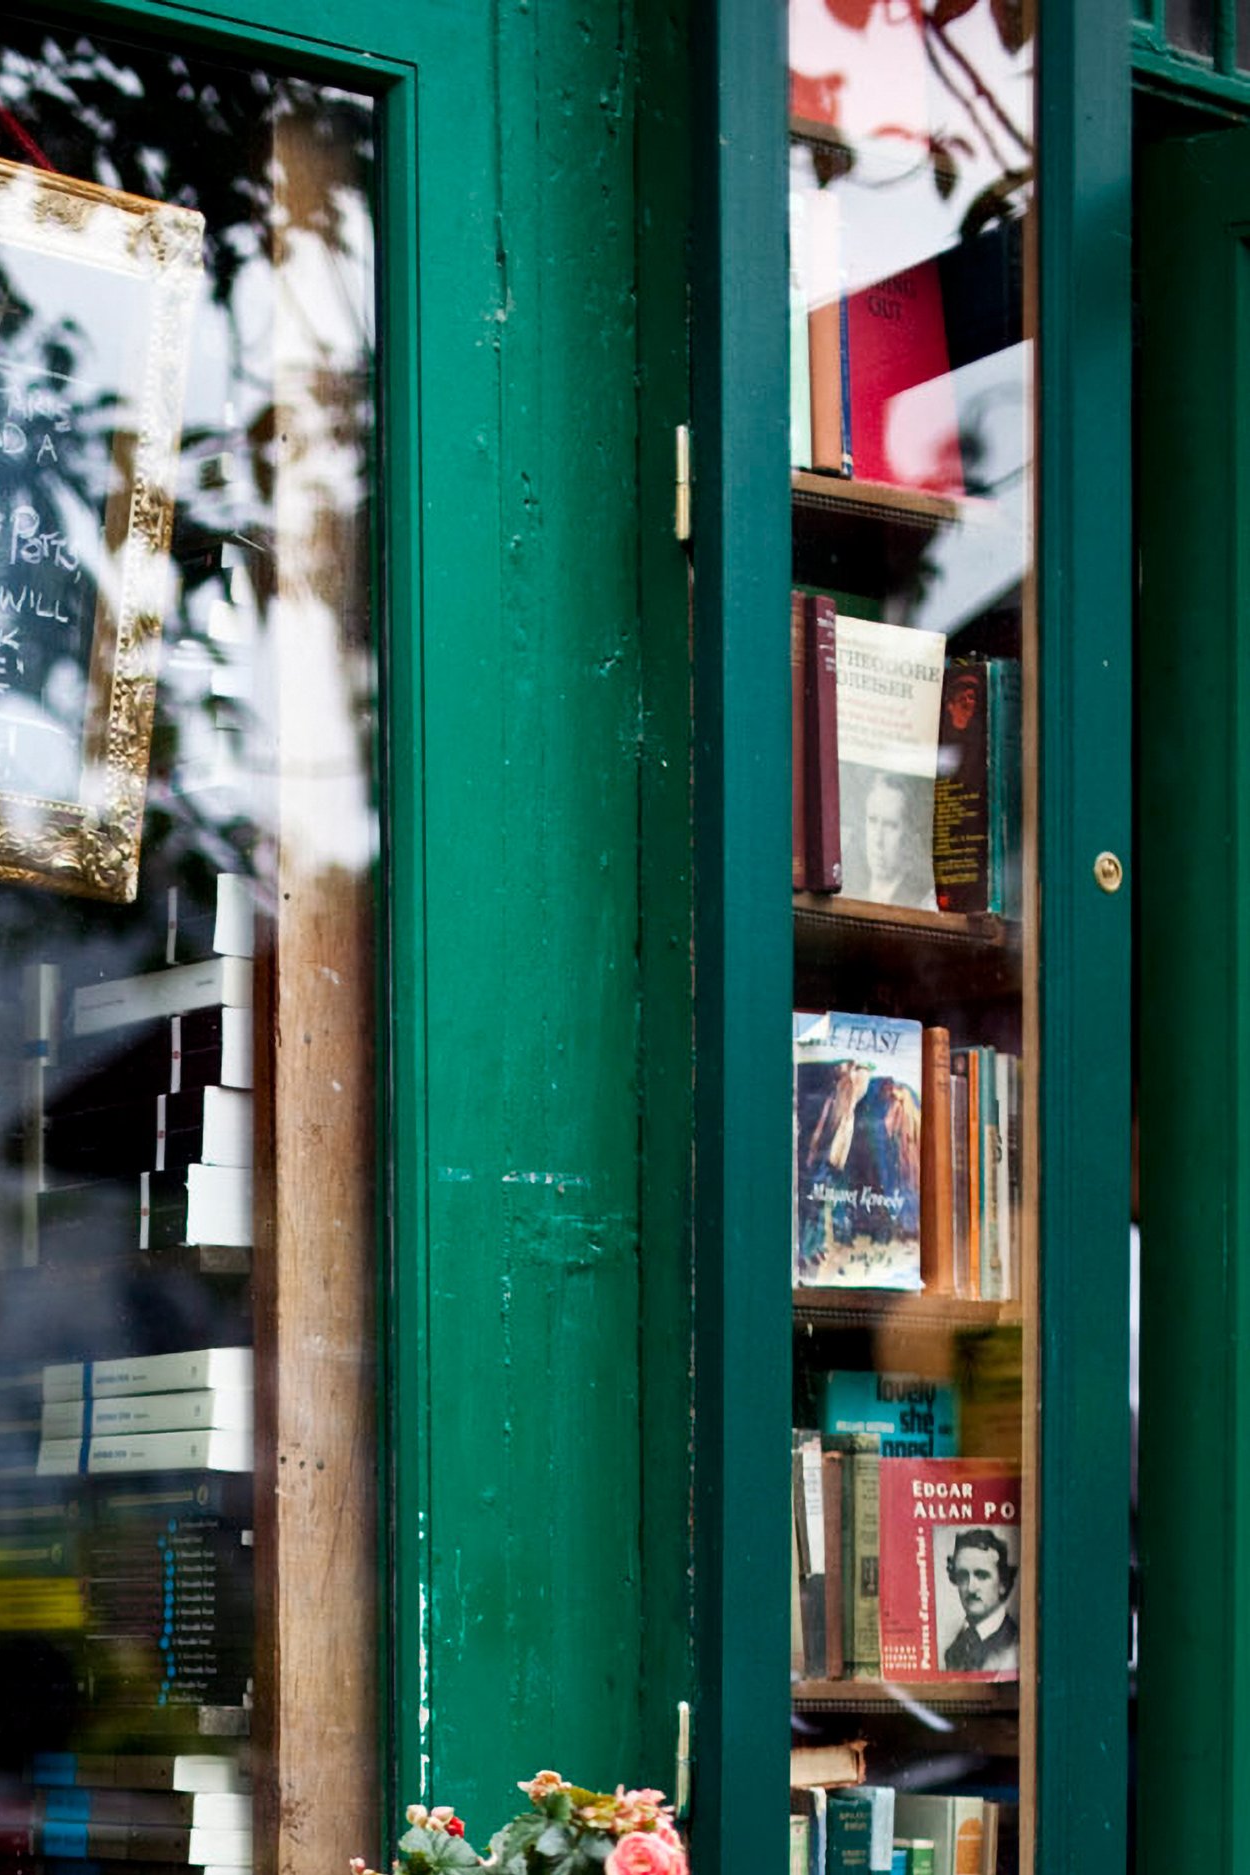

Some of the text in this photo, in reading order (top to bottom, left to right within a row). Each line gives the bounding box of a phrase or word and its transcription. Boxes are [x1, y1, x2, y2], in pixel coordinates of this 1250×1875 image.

[36, 433, 58, 465] A
[0, 585, 69, 622] WILL
[849, 1026, 902, 1056] FEAST
[899, 1404, 935, 1435] she
[912, 1479, 973, 1499] EDGAR
[914, 1501, 1016, 1520] ALLAN PO
